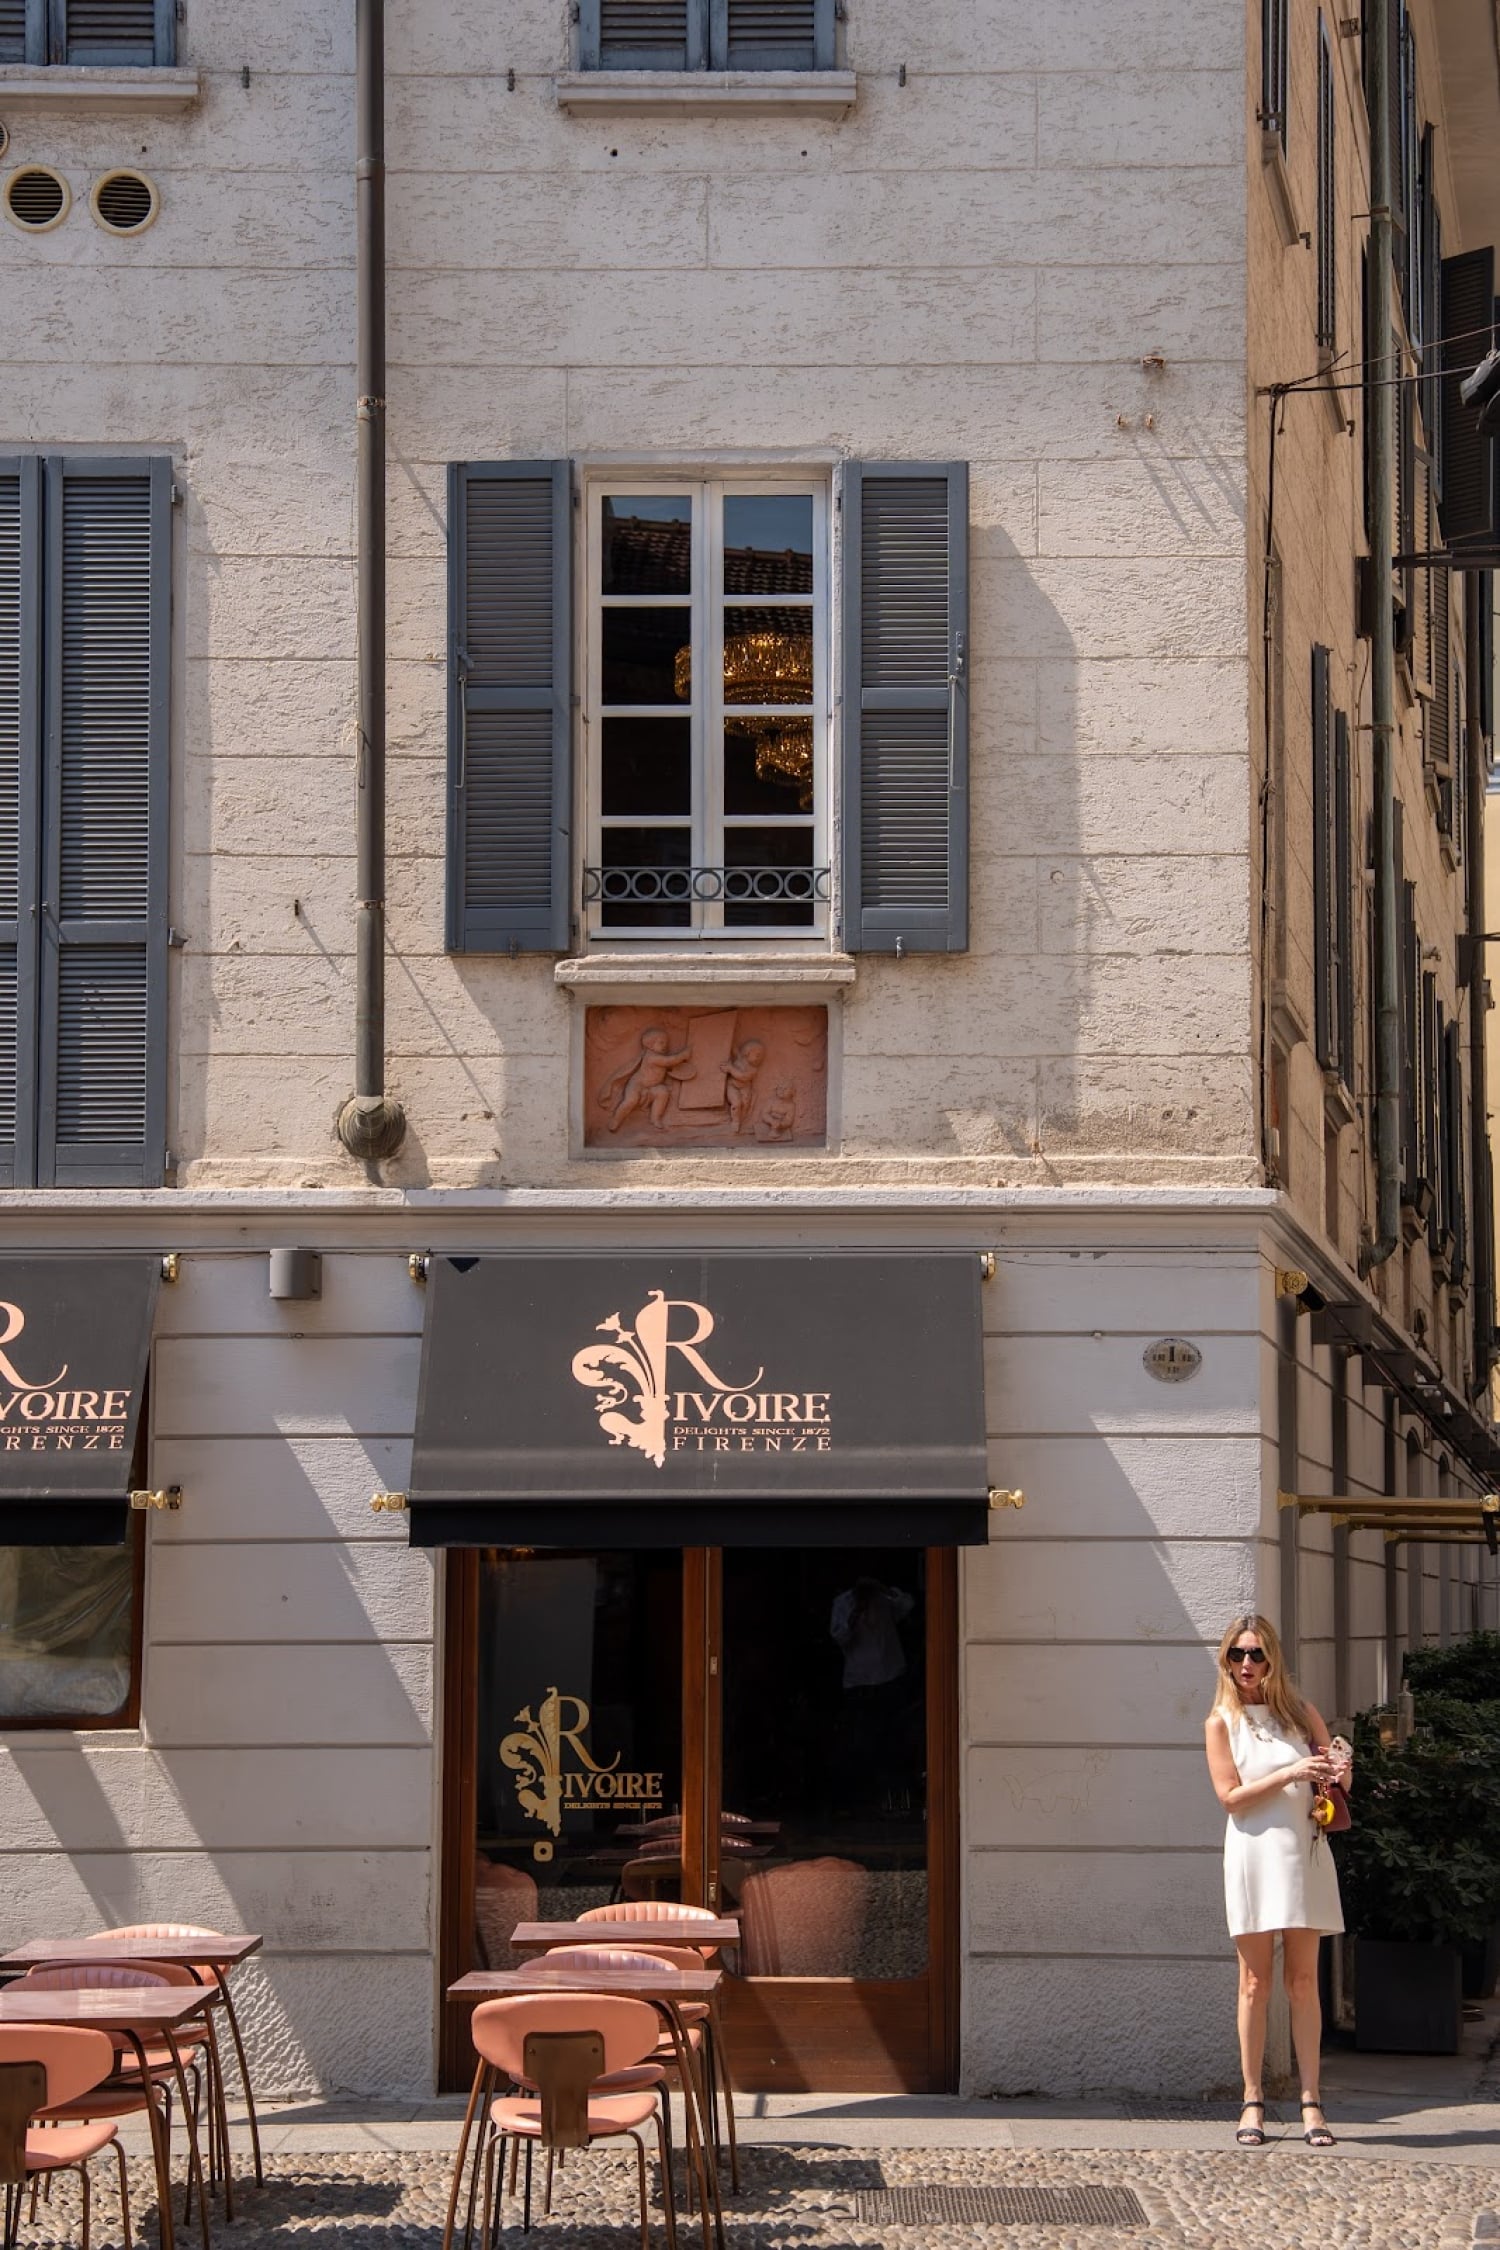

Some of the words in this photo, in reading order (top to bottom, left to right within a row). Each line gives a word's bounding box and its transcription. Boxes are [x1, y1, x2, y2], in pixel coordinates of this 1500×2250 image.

[45, 1425, 89, 1434] SINCE
[673, 1427, 747, 1436] DELIGHTS
[752, 1428, 795, 1436] SINCE
[802, 1428, 831, 1436] 1872
[672, 1437, 832, 1451] FIRENZE
[539, 1690, 663, 1798] RIVOIRE
